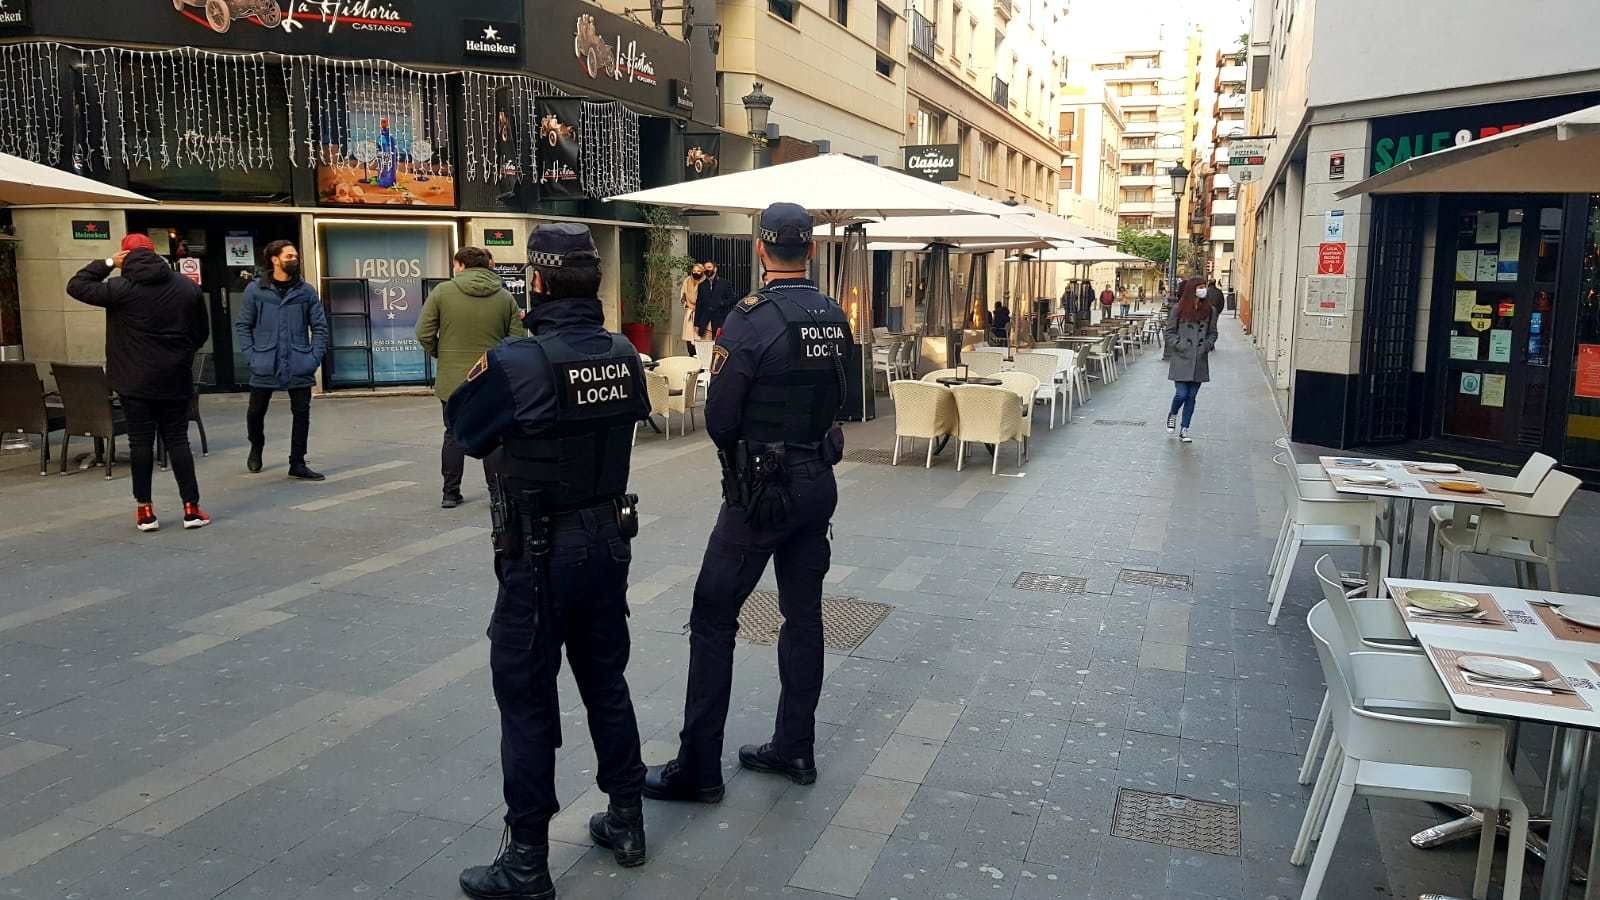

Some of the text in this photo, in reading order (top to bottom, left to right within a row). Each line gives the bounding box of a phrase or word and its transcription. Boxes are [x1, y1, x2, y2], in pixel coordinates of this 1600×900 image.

[466, 40, 516, 54] Heineken
[908, 156, 954, 168] Classics
[375, 287, 408, 311] 12
[801, 326, 845, 340] POLICIA
[806, 343, 842, 358] LOCL
[568, 362, 631, 384] POLICIA
[577, 384, 629, 405] LOCAL
